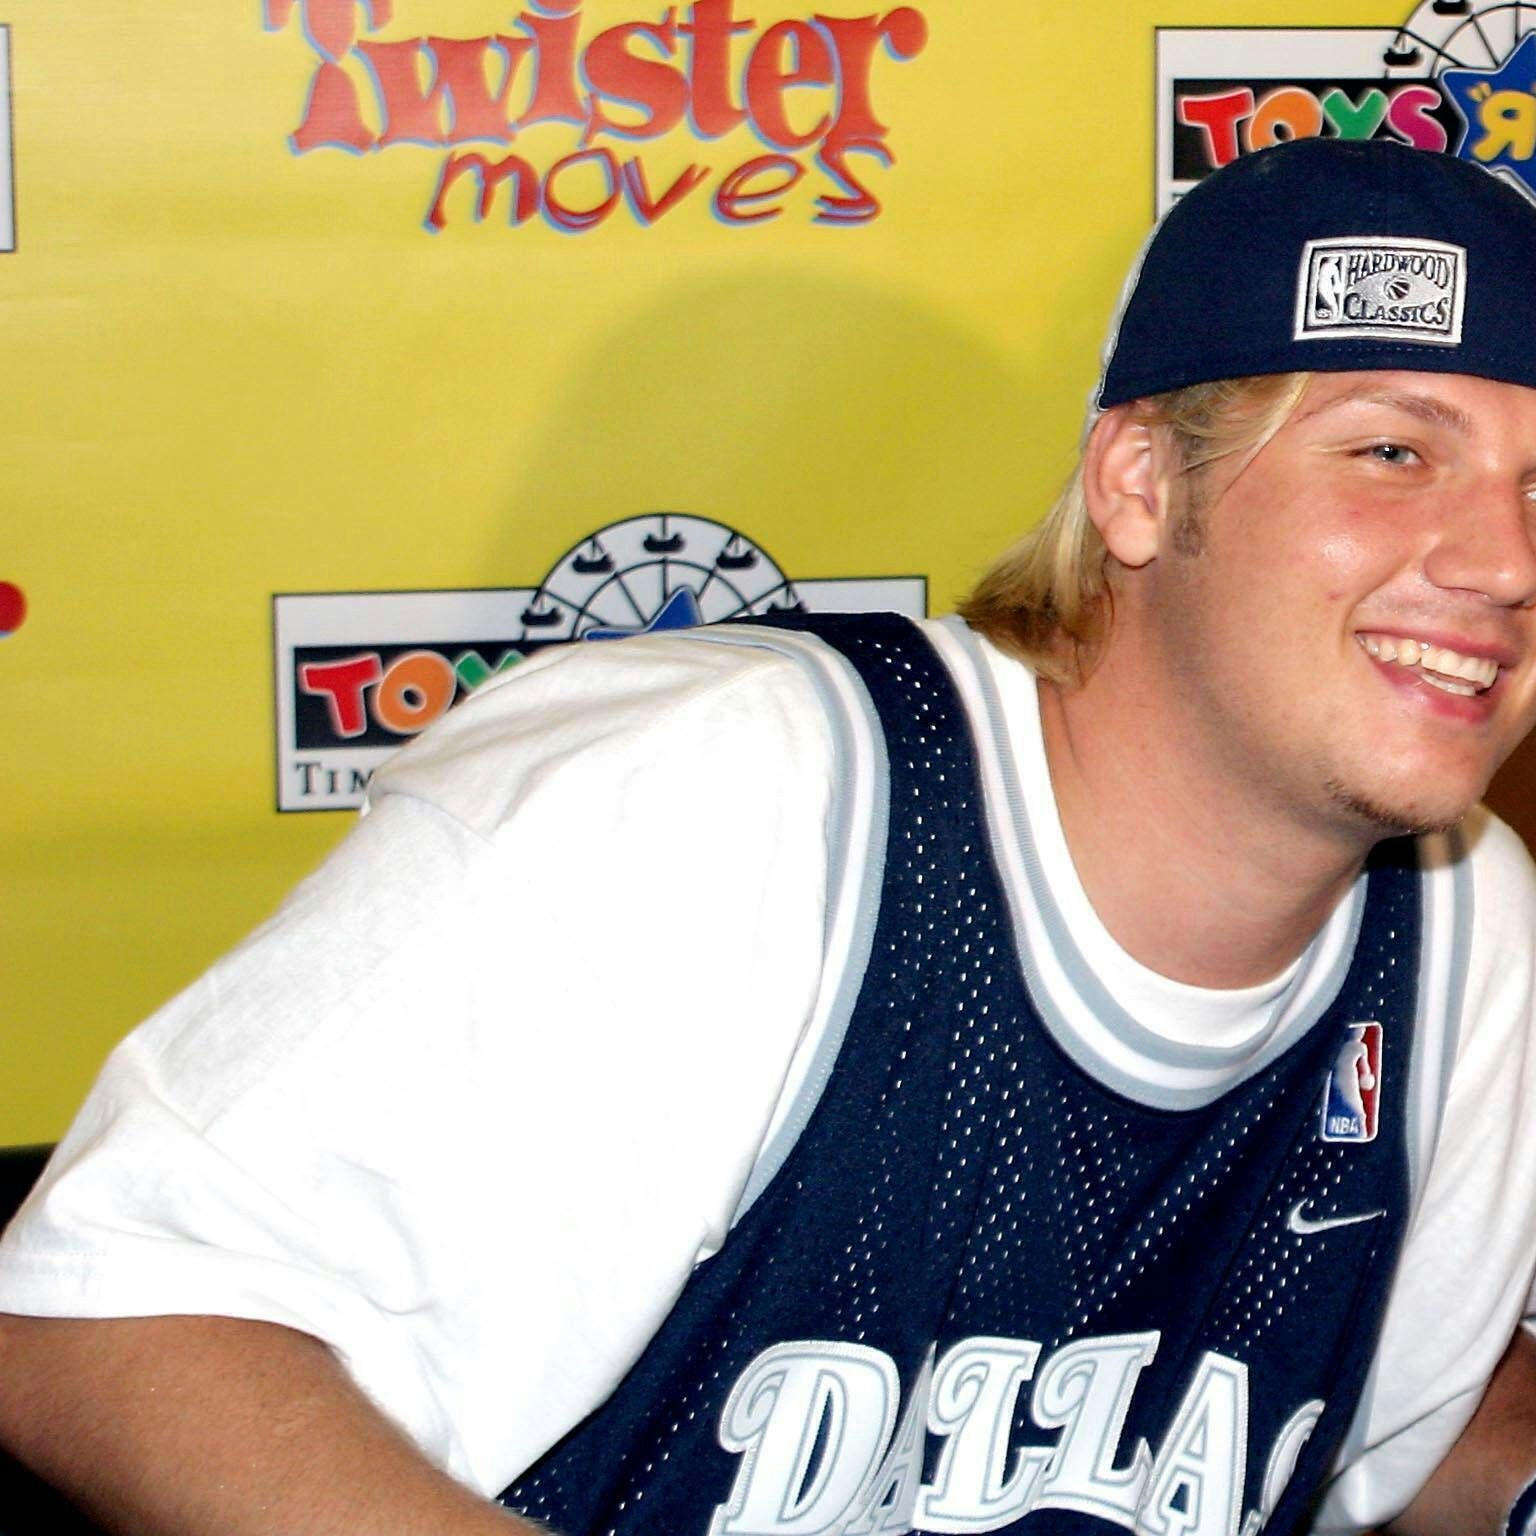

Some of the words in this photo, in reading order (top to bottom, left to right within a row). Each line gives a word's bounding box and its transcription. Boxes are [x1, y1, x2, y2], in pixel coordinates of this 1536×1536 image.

[262, 0, 928, 156] Twister
[1180, 85, 1448, 169] TOYS
[422, 134, 896, 234] moves
[1348, 251, 1450, 290] HARDWOOD
[1344, 293, 1450, 325] CLASSICS
[295, 762, 376, 795] TIM
[1330, 1116, 1359, 1134] NBA
